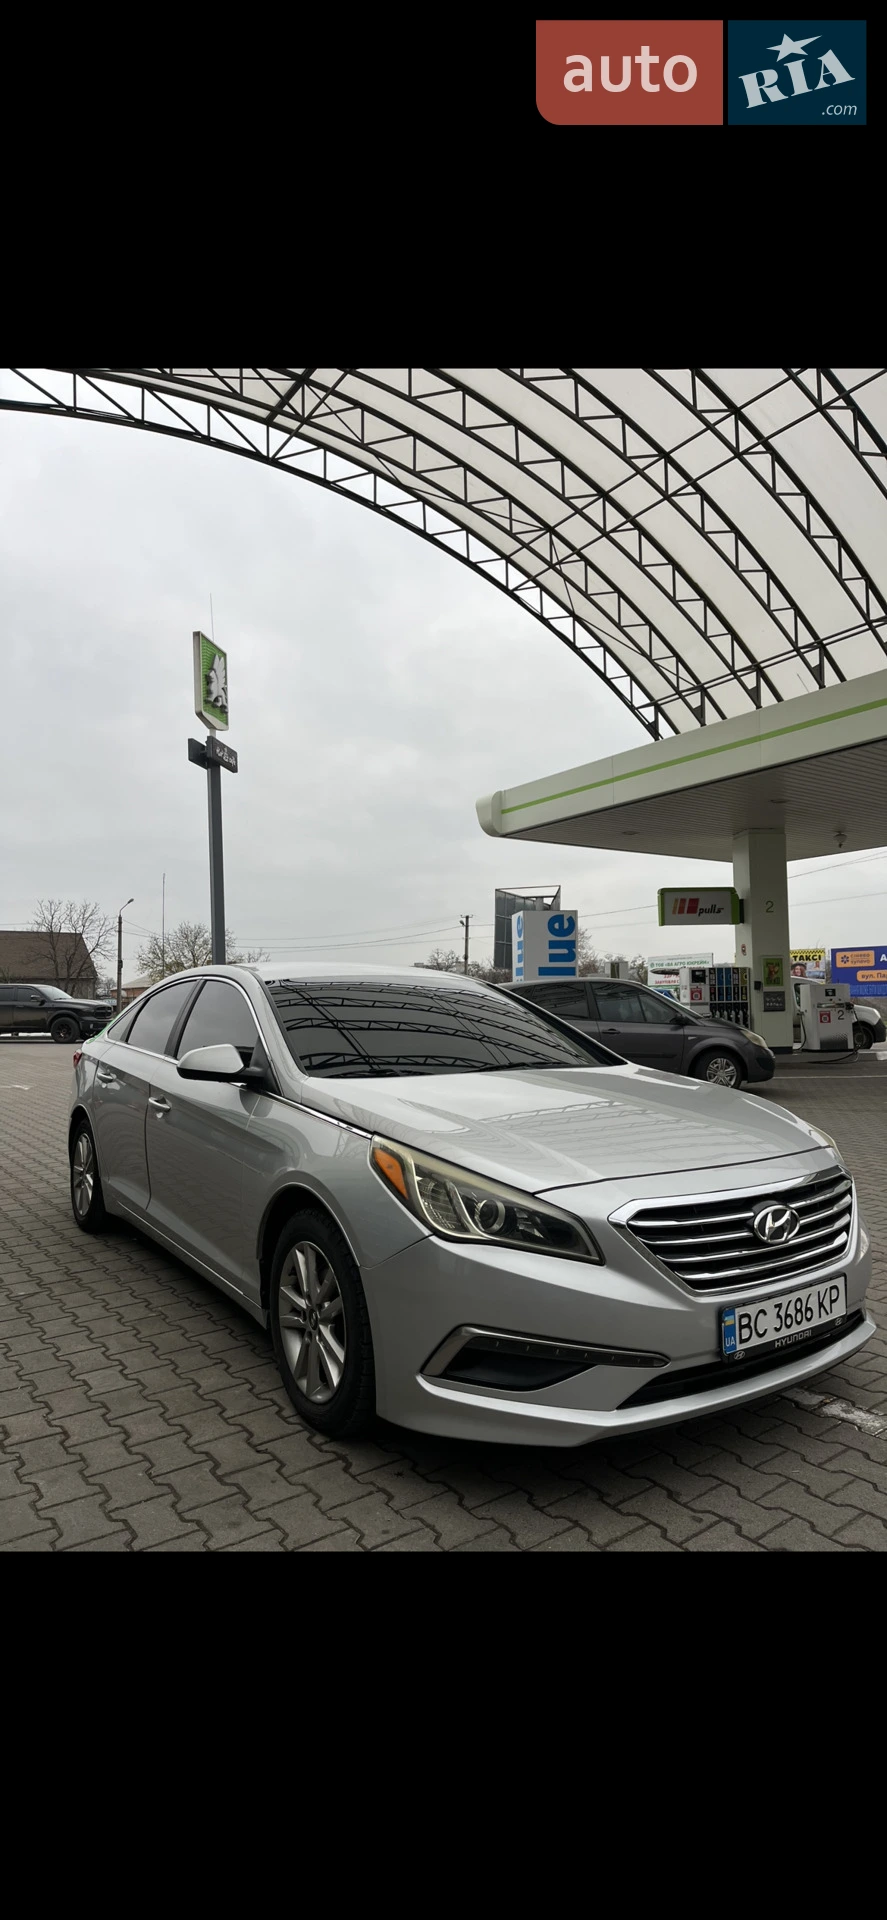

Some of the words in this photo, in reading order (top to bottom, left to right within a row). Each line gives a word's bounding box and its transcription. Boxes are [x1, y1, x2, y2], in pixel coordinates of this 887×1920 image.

[698, 904, 724, 917] pulls
[765, 900, 774, 913] 2
[837, 1009, 845, 1021] 2
[773, 1293, 814, 1333] 3686
[725, 1336, 736, 1347] UA
[774, 1329, 812, 1348] HYUNDAI
